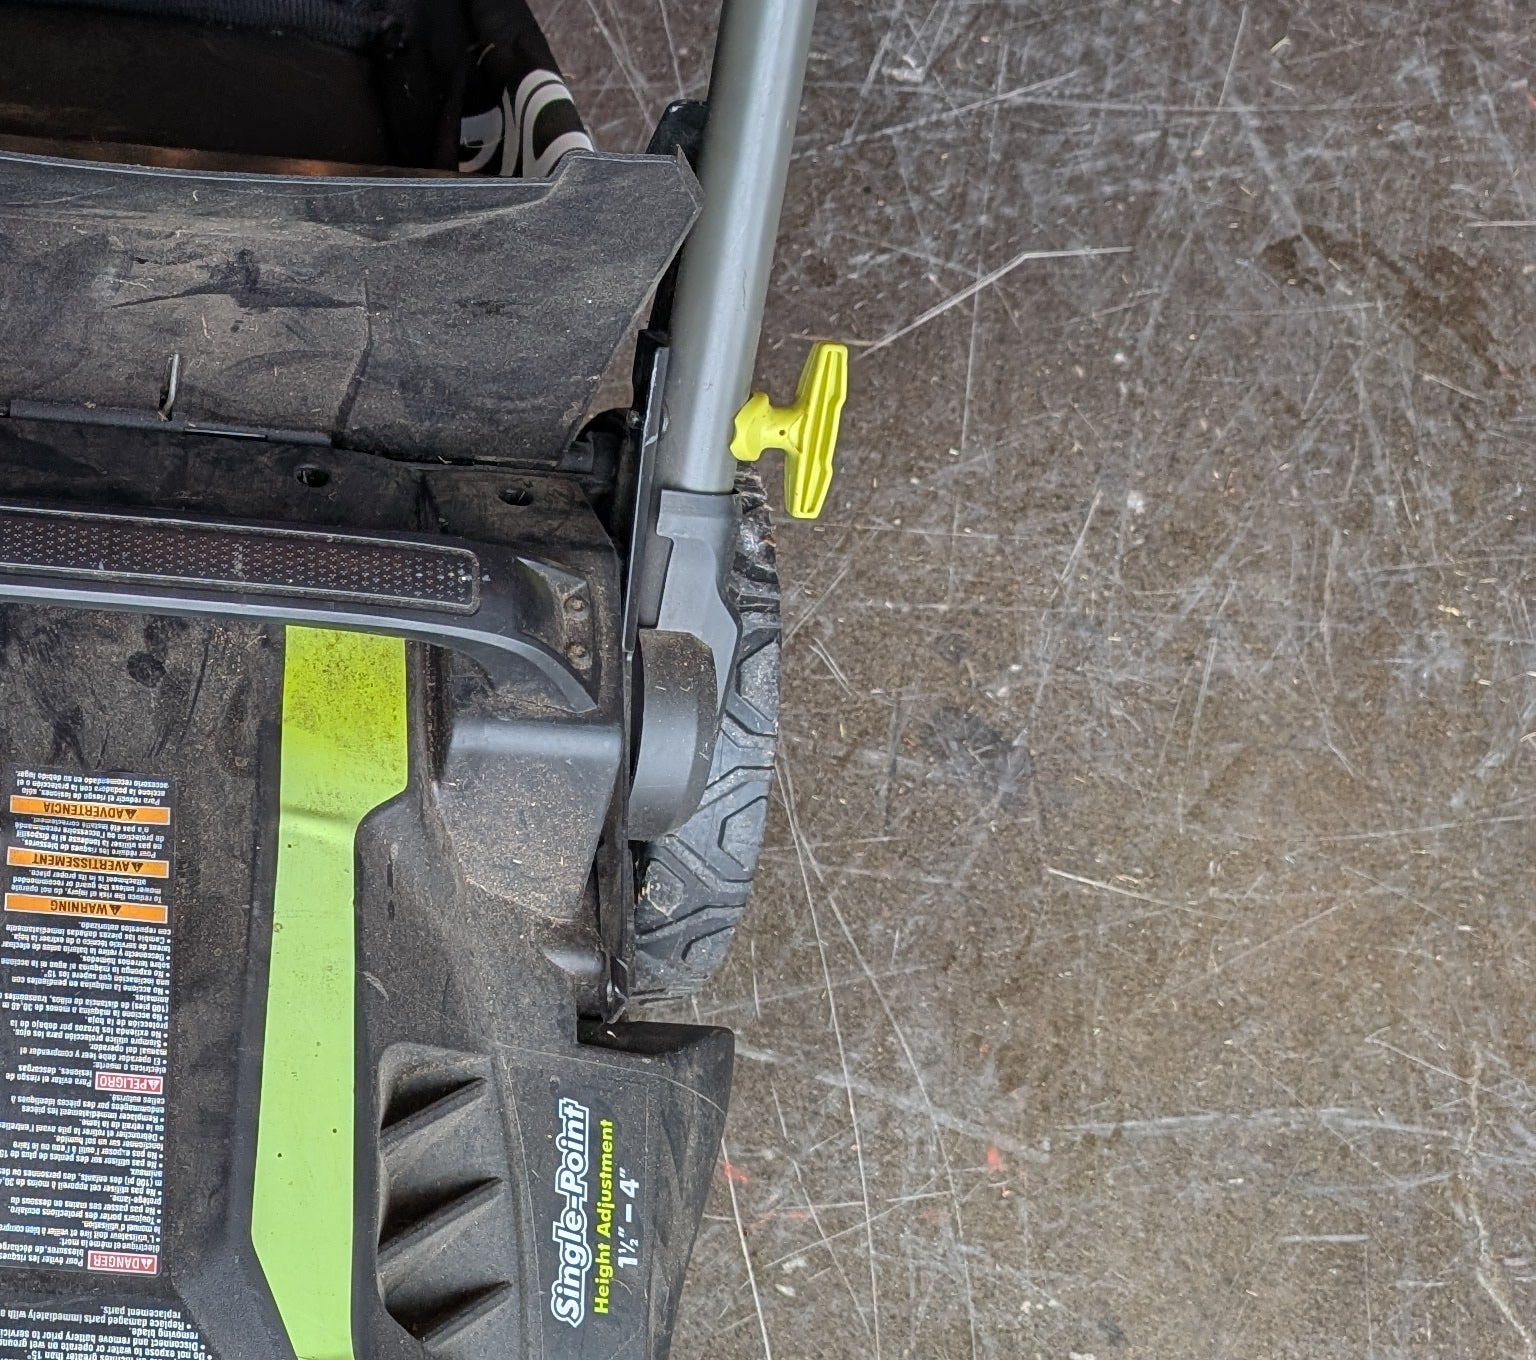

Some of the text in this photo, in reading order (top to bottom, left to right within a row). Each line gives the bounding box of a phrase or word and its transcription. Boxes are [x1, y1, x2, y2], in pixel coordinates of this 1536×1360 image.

[42, 802, 123, 817] ADVERTENCIA
[31, 853, 129, 871] AVERTISSEMENT
[49, 899, 108, 914] WARNING
[99, 1075, 147, 1089] PELIGRO
[551, 1097, 591, 1327] Single-Point
[594, 1119, 615, 1314] Height Adjustment
[93, 1255, 139, 1268] DANGER
[7, 1309, 26, 1318] with
[28, 1309, 82, 1322] immediately
[100, 1304, 180, 1319] replacement parts.
[83, 1313, 105, 1324] parts
[107, 1314, 147, 1327] damaged
[149, 1317, 184, 1329] Replace
[31, 1331, 40, 1339] to
[41, 1330, 63, 1341] prior
[65, 1331, 95, 1343] battery
[97, 1335, 130, 1343] remove
[128, 1327, 198, 1340] removing blade.
[29, 1340, 45, 1349] wet
[60, 1340, 93, 1352] operate
[132, 1337, 148, 1346] and
[150, 1339, 198, 1350] Disconnect
[44, 1351, 63, 1360] than
[106, 1345, 131, 1355] water
[133, 1347, 142, 1356] to
[144, 1346, 175, 1356] expose
[176, 1350, 191, 1359] not
[192, 1351, 205, 1360] Do
